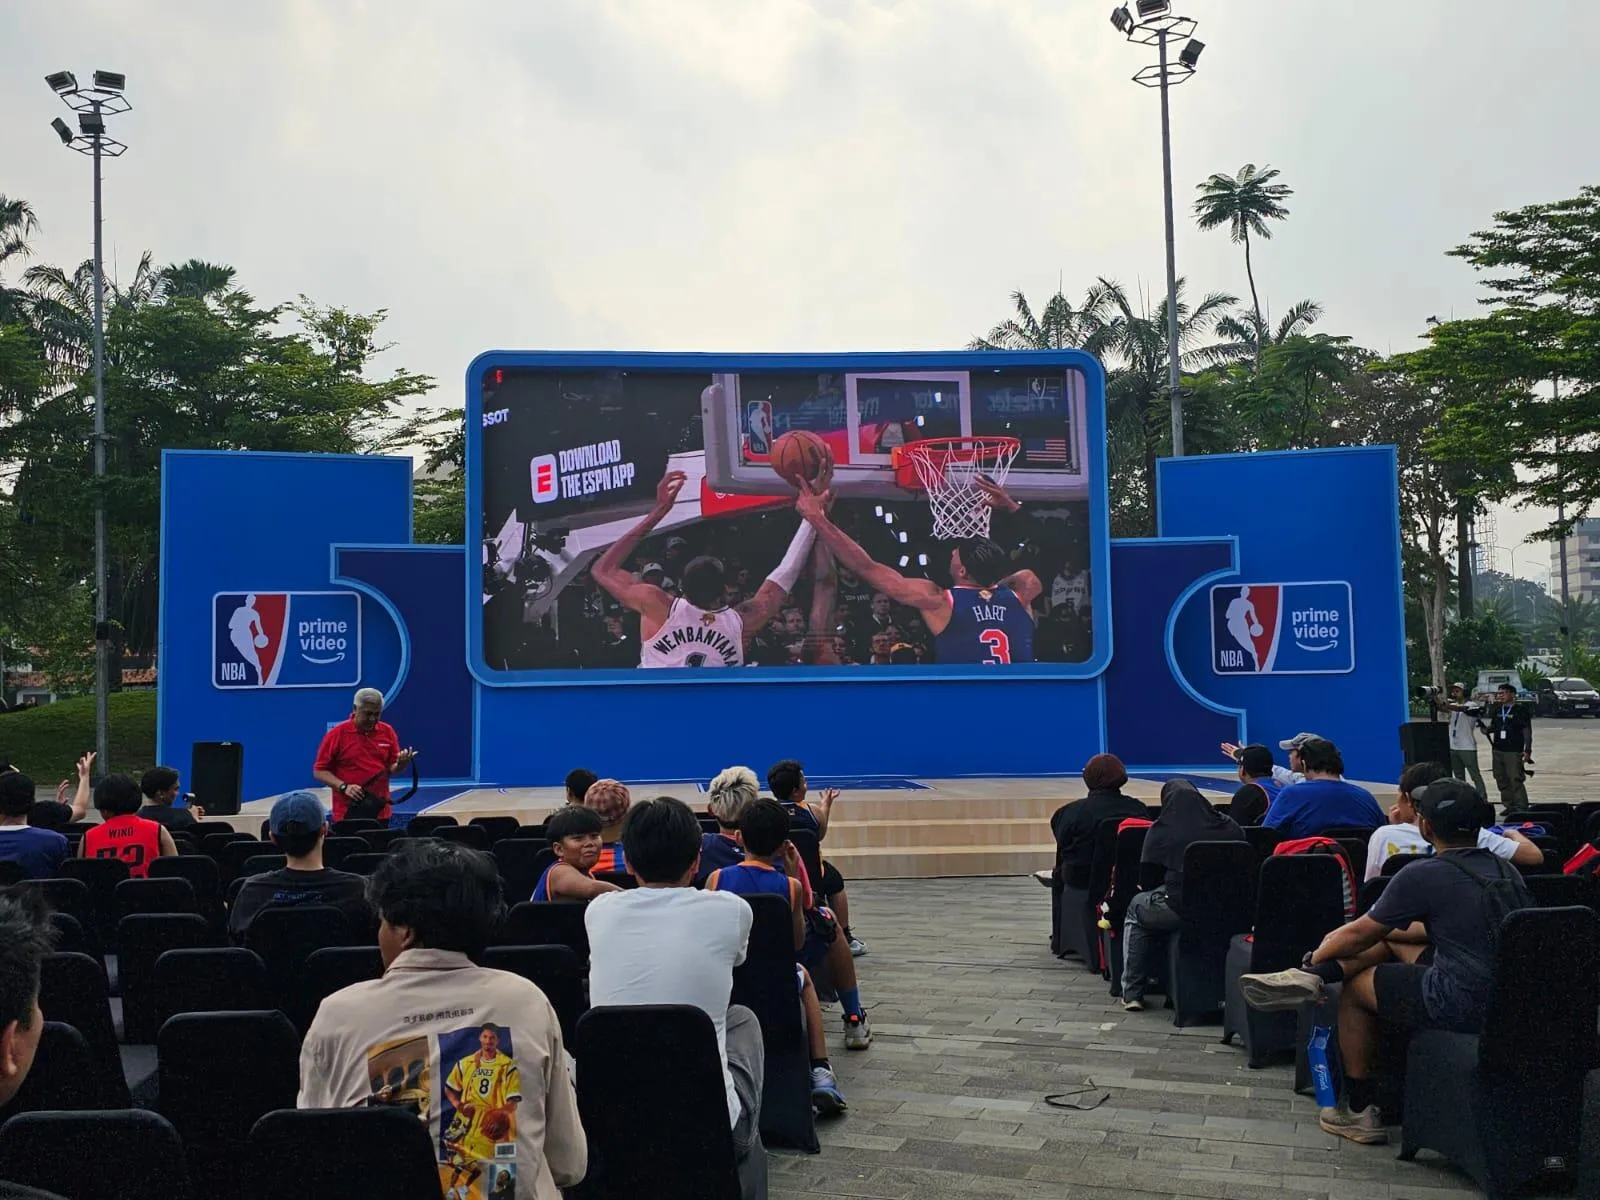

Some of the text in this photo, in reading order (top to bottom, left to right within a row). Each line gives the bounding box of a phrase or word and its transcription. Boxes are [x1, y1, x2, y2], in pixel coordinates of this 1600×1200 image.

[559, 440, 621, 473] DOWNLOAD
[561, 462, 635, 498] THE ESPN APP
[972, 605, 1006, 622] HART
[1292, 607, 1339, 625] prime
[299, 618, 348, 636] prime
[1294, 624, 1339, 638] video
[300, 635, 347, 650] video
[979, 629, 1011, 664] 3
[1220, 650, 1244, 667] NBA
[221, 662, 247, 681] NBA
[479, 1078, 490, 1094] 8
